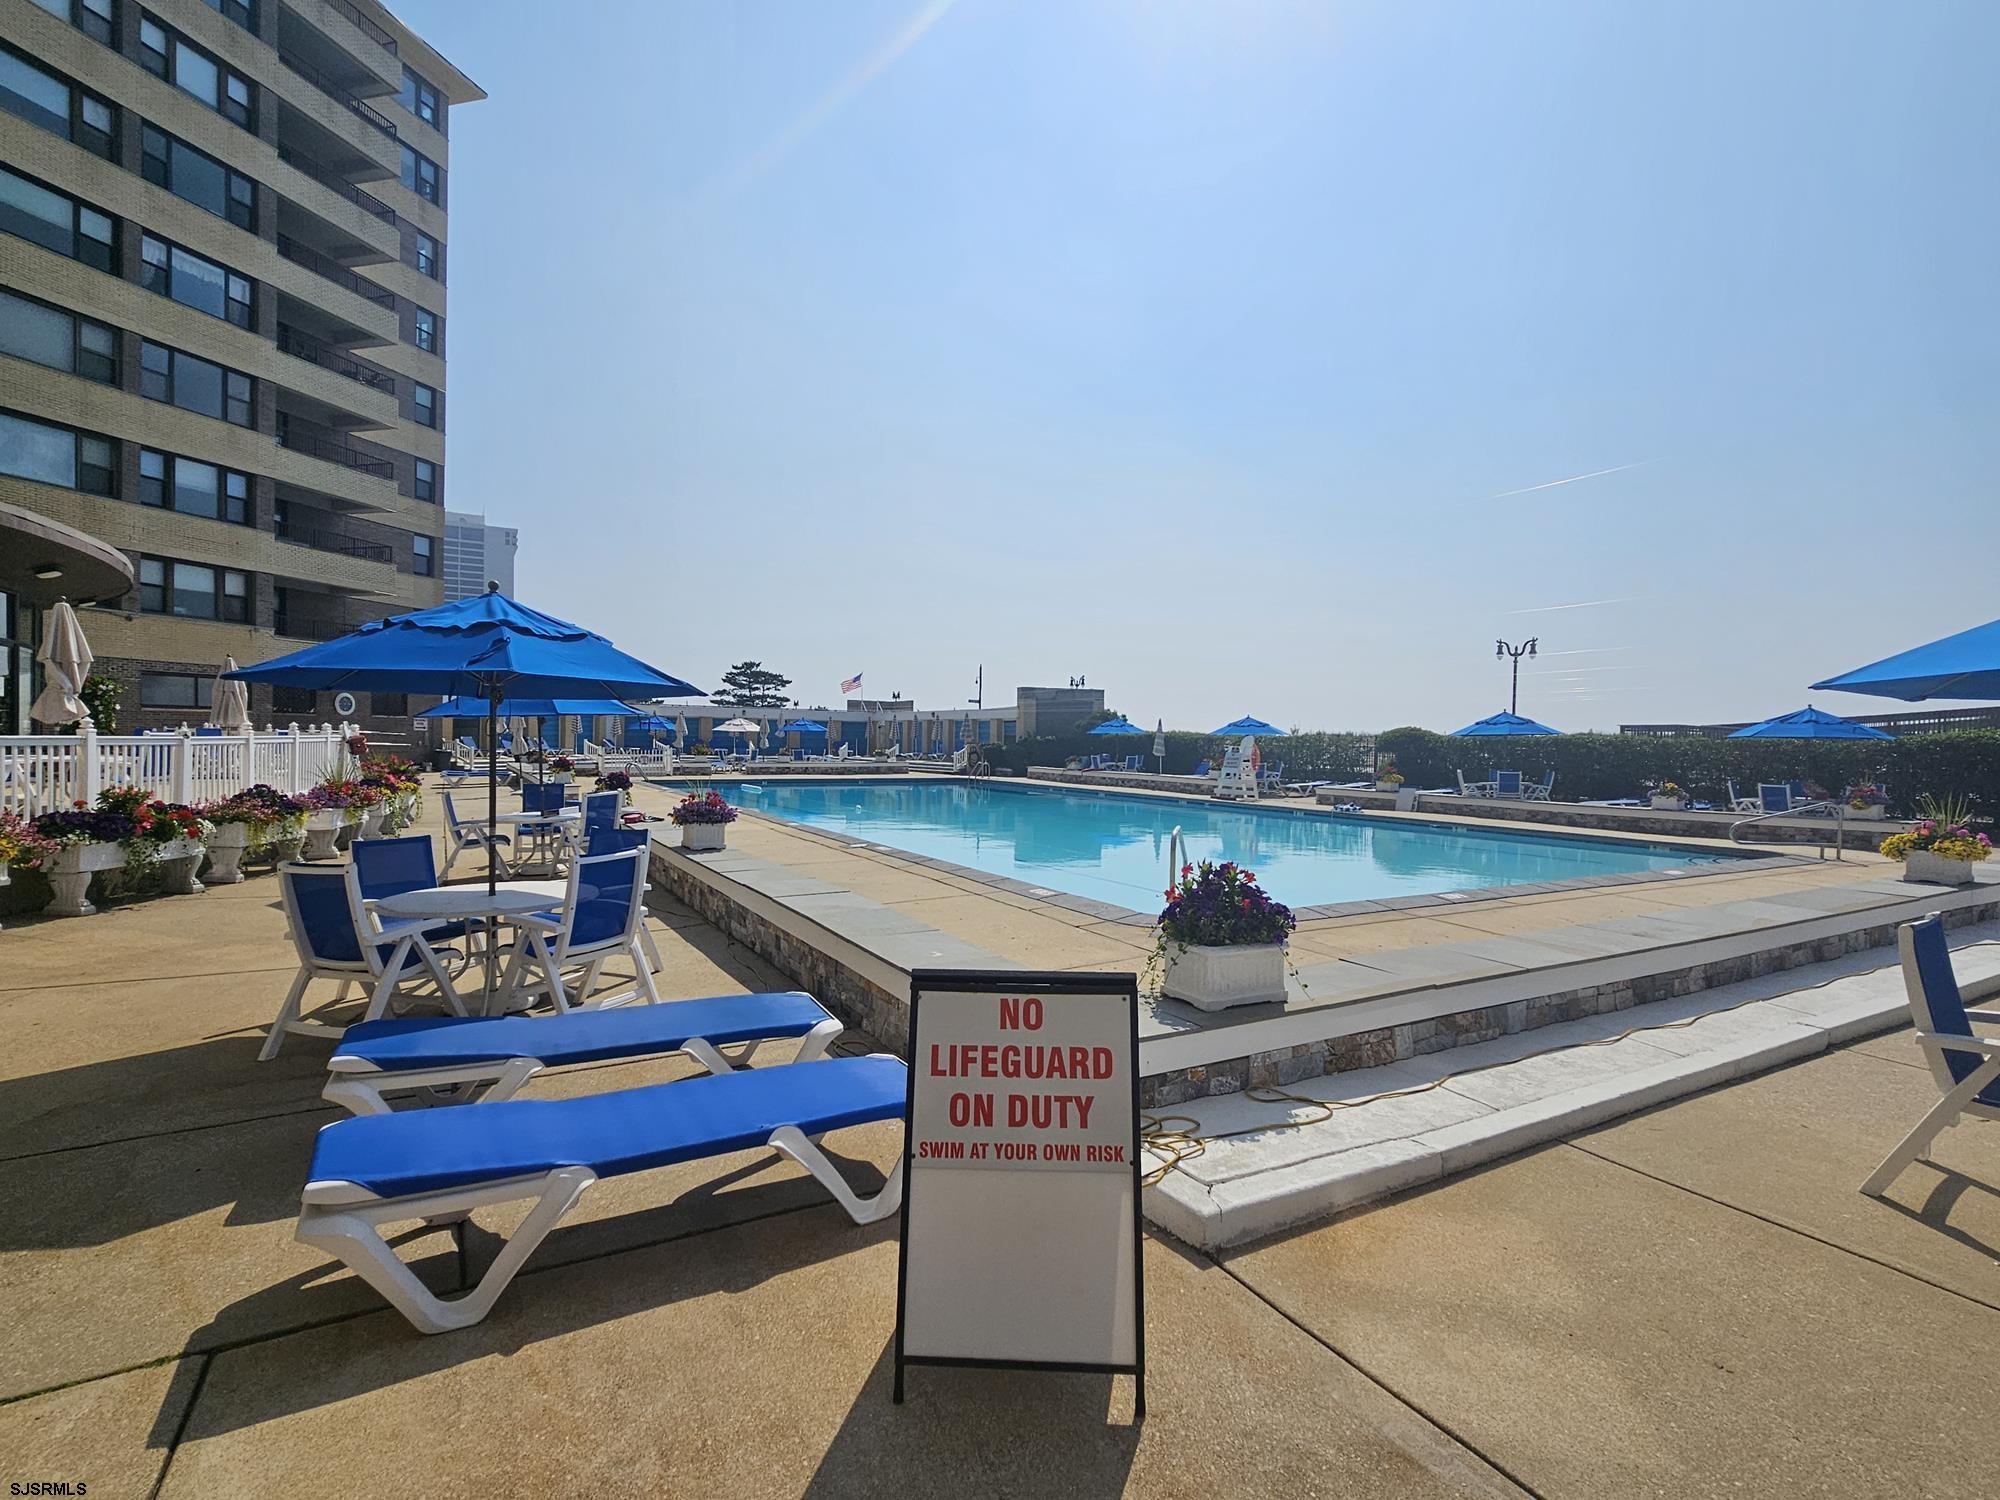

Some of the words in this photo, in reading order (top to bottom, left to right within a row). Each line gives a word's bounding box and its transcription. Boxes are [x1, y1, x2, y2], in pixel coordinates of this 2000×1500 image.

[1000, 998, 1043, 1030] NO
[930, 1044, 1113, 1080] LIFEGUARD
[950, 1093, 994, 1127] ON
[1008, 1095, 1094, 1129] DUTY
[919, 1141, 964, 1159] SWIM
[970, 1143, 989, 1159] AT
[994, 1144, 1037, 1161] YOUR
[1043, 1145, 1080, 1161] OWN
[1087, 1145, 1124, 1162] RISK
